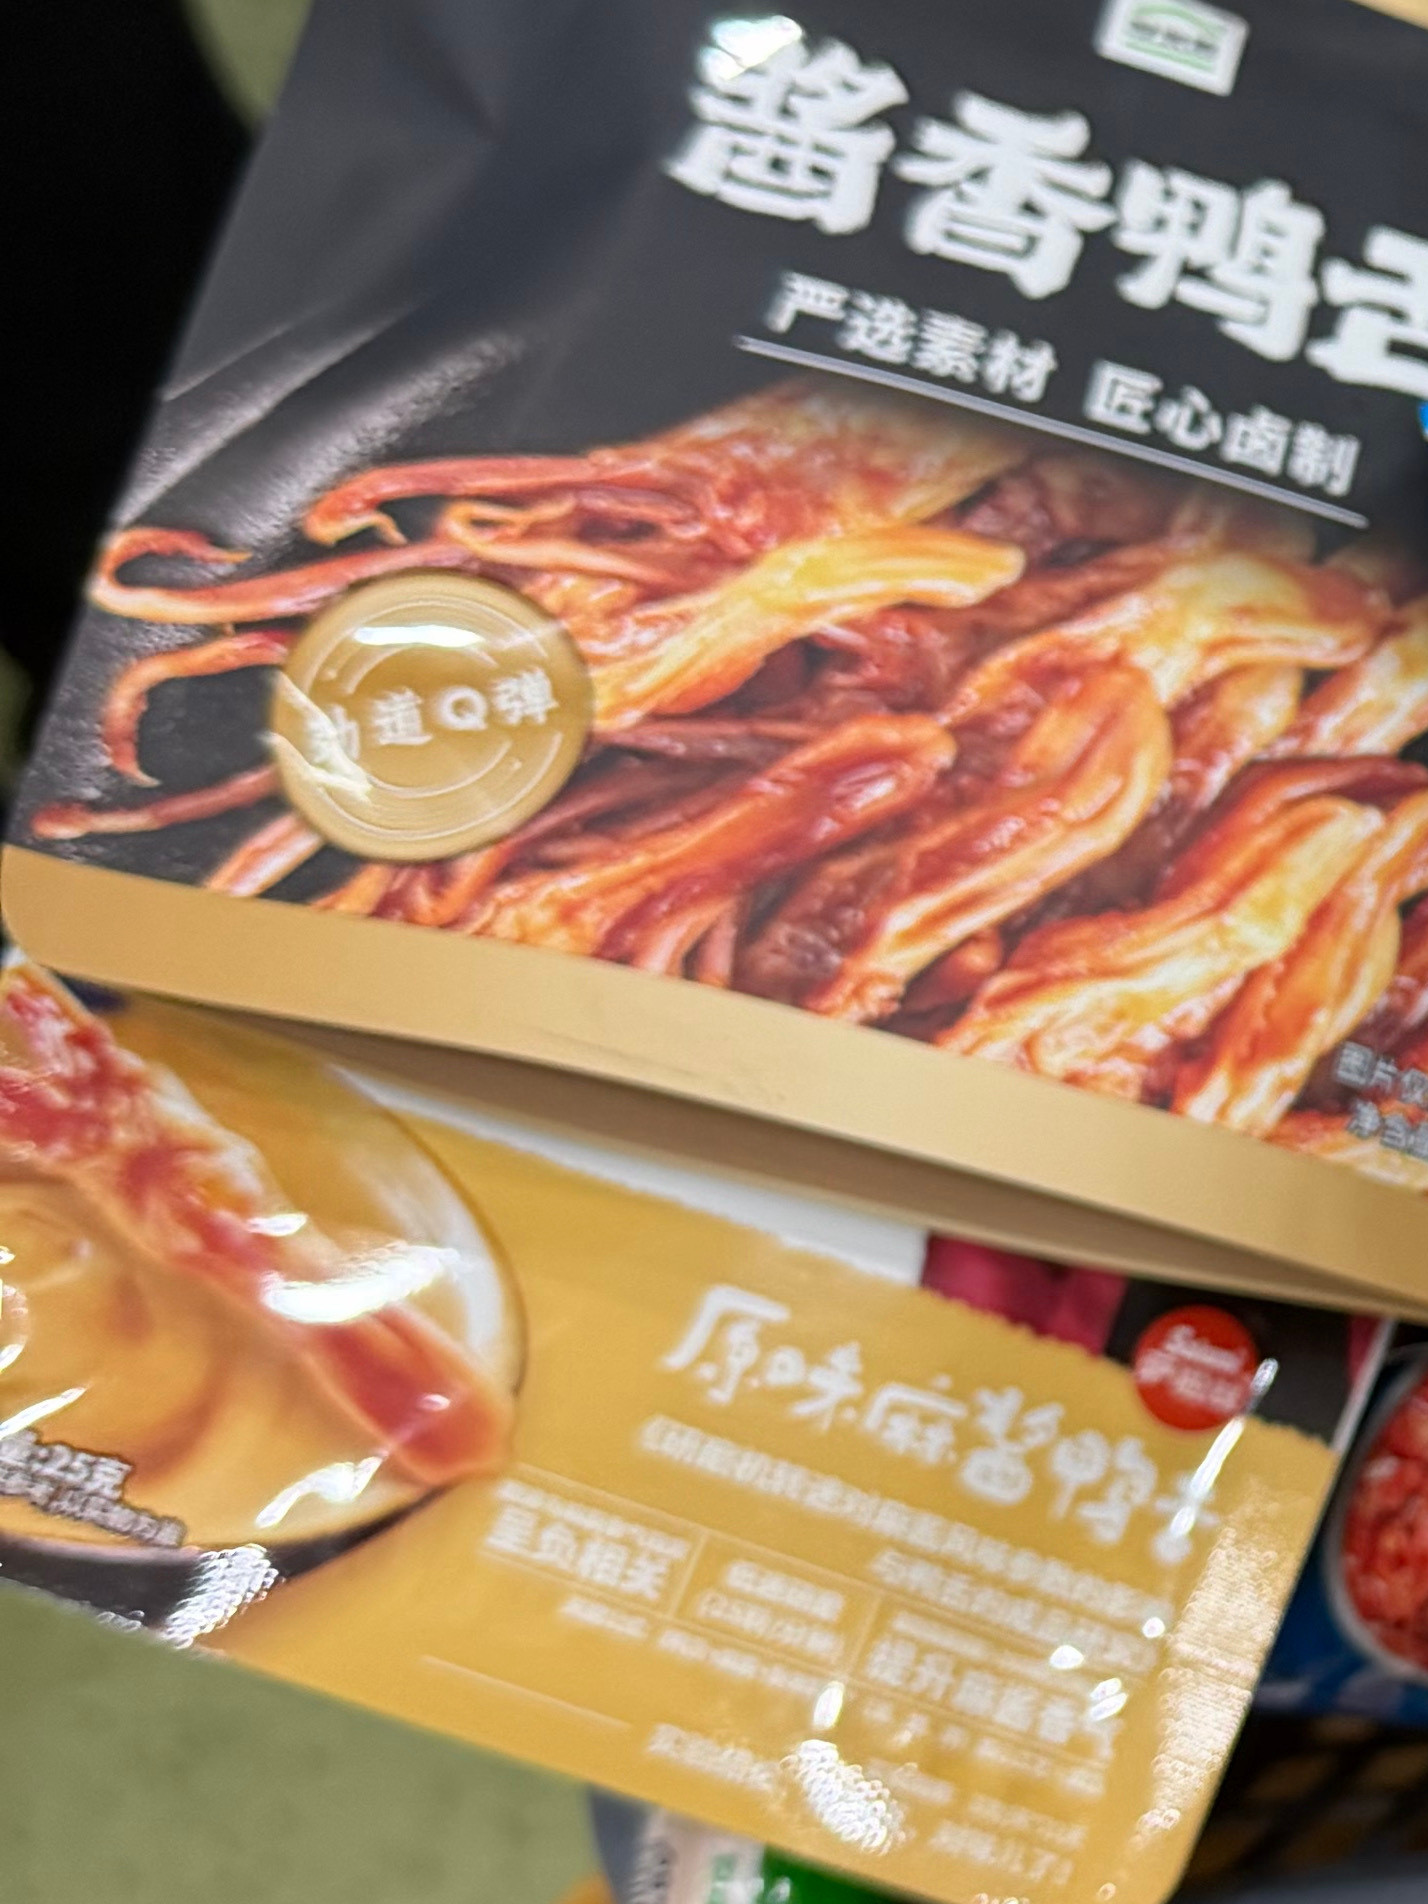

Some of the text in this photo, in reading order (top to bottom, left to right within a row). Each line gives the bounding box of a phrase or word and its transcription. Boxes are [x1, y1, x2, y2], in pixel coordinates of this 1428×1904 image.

[765, 271, 1362, 496] 严选素材 匠心卤制
[303, 668, 560, 764] 劲道Q弹
